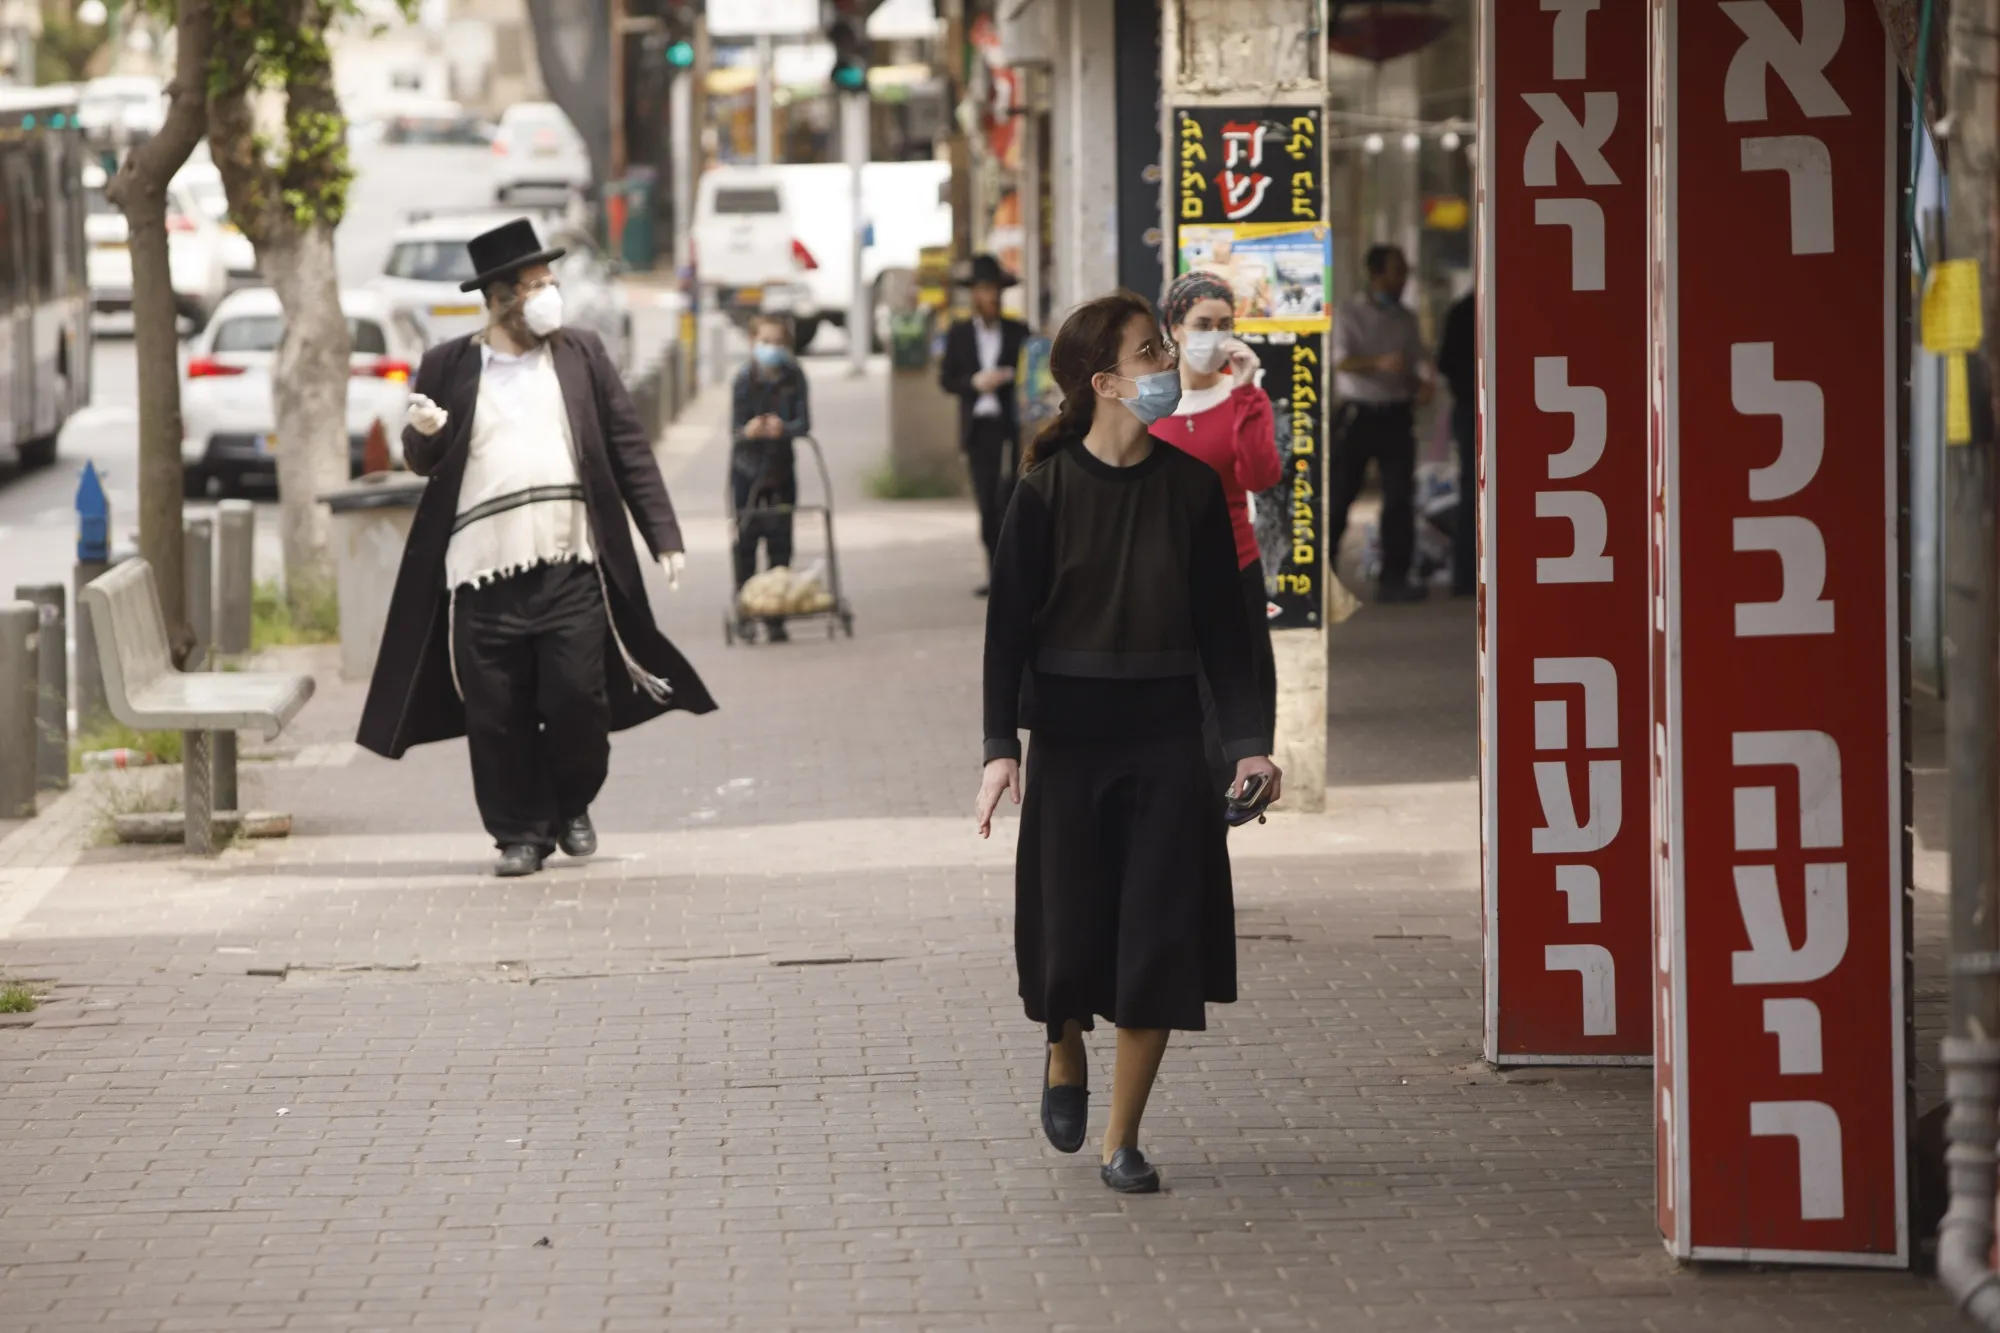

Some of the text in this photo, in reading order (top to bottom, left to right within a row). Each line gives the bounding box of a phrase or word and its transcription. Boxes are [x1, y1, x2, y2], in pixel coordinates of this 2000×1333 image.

[1181, 116, 1208, 219] עציצים
[1285, 116, 1318, 219] כלי בית
[1292, 344, 1318, 455] צעצועים
[1534, 356, 1614, 583] לב
[1717, 0, 1852, 1220] אר לב העיר
[1532, 656, 1622, 1036] העיר
